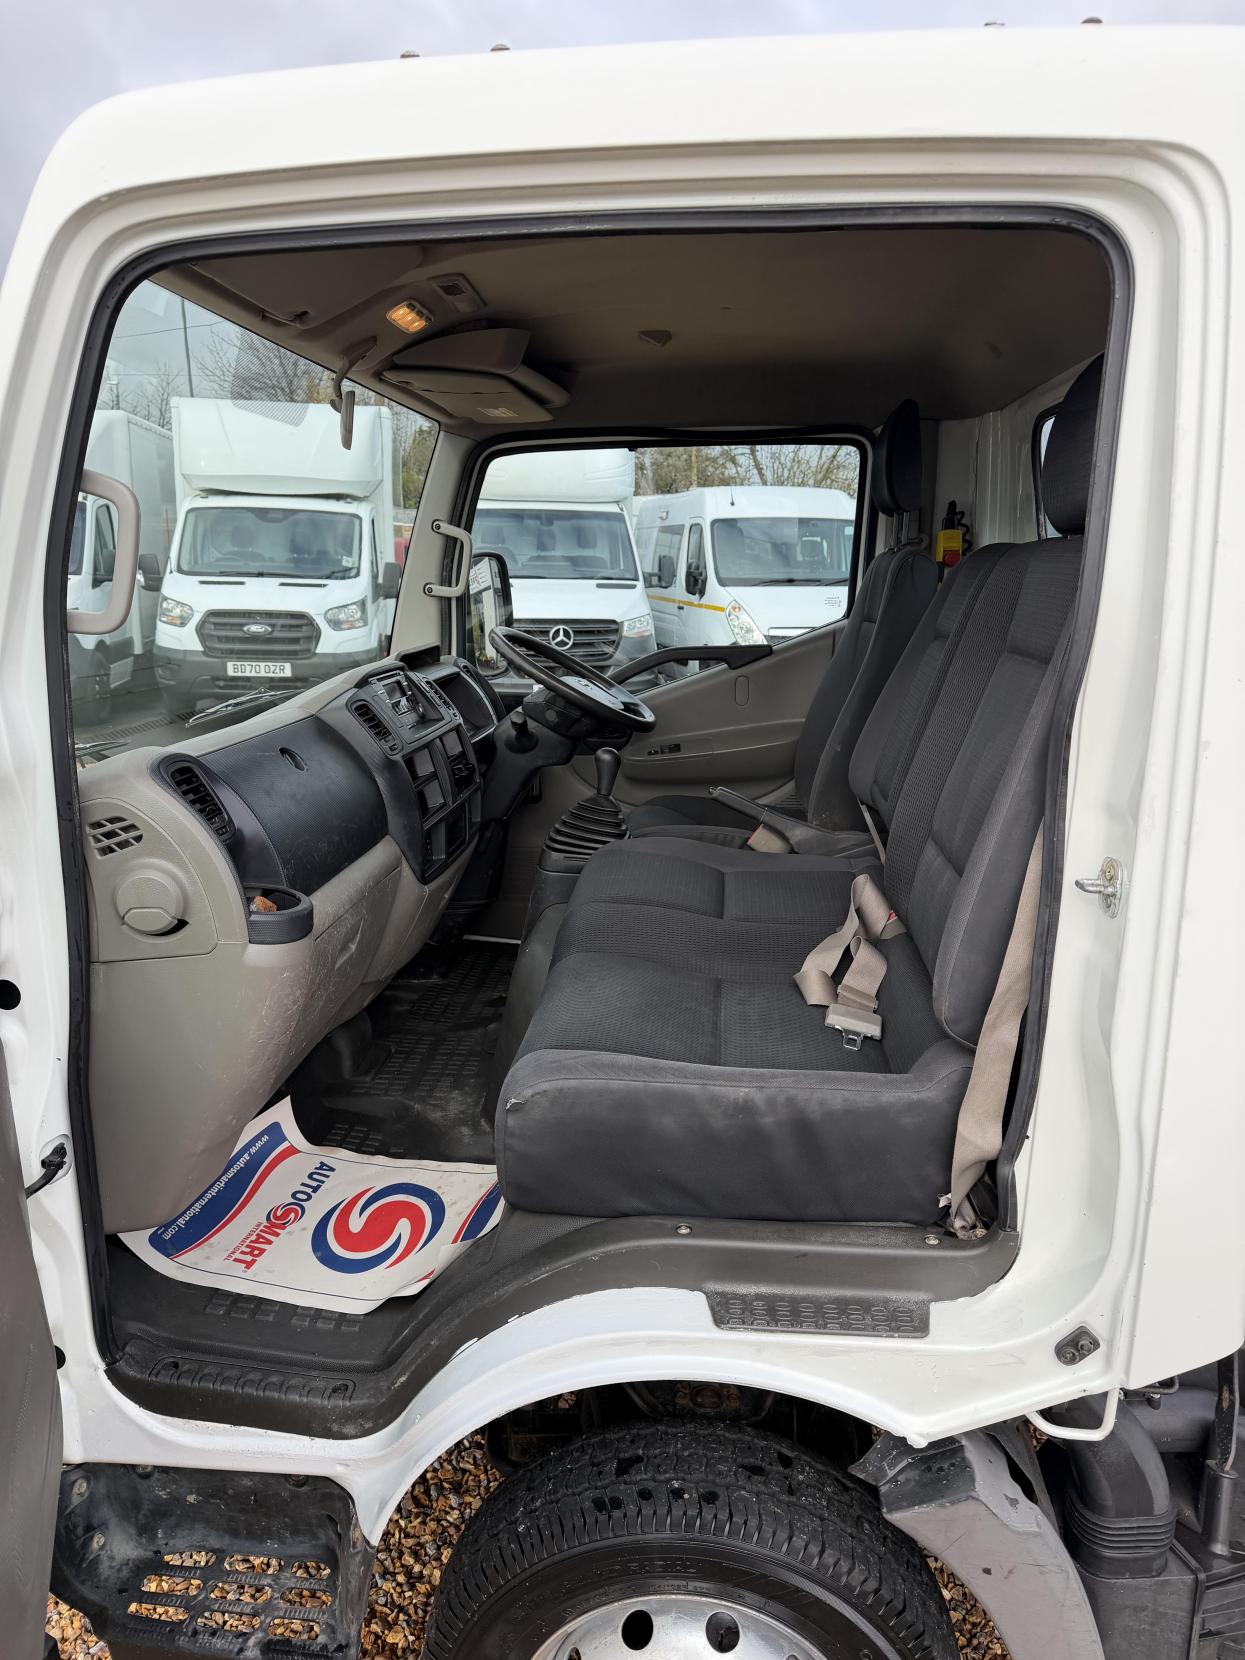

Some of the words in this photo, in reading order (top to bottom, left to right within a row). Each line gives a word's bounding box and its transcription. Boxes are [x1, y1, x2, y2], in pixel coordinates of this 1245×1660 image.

[232, 663, 261, 674] BD70
[264, 664, 286, 675] OZR
[162, 1134, 270, 1241] www.autosmartinternational.com
[223, 1221, 264, 1261] INTERNATIONAL
